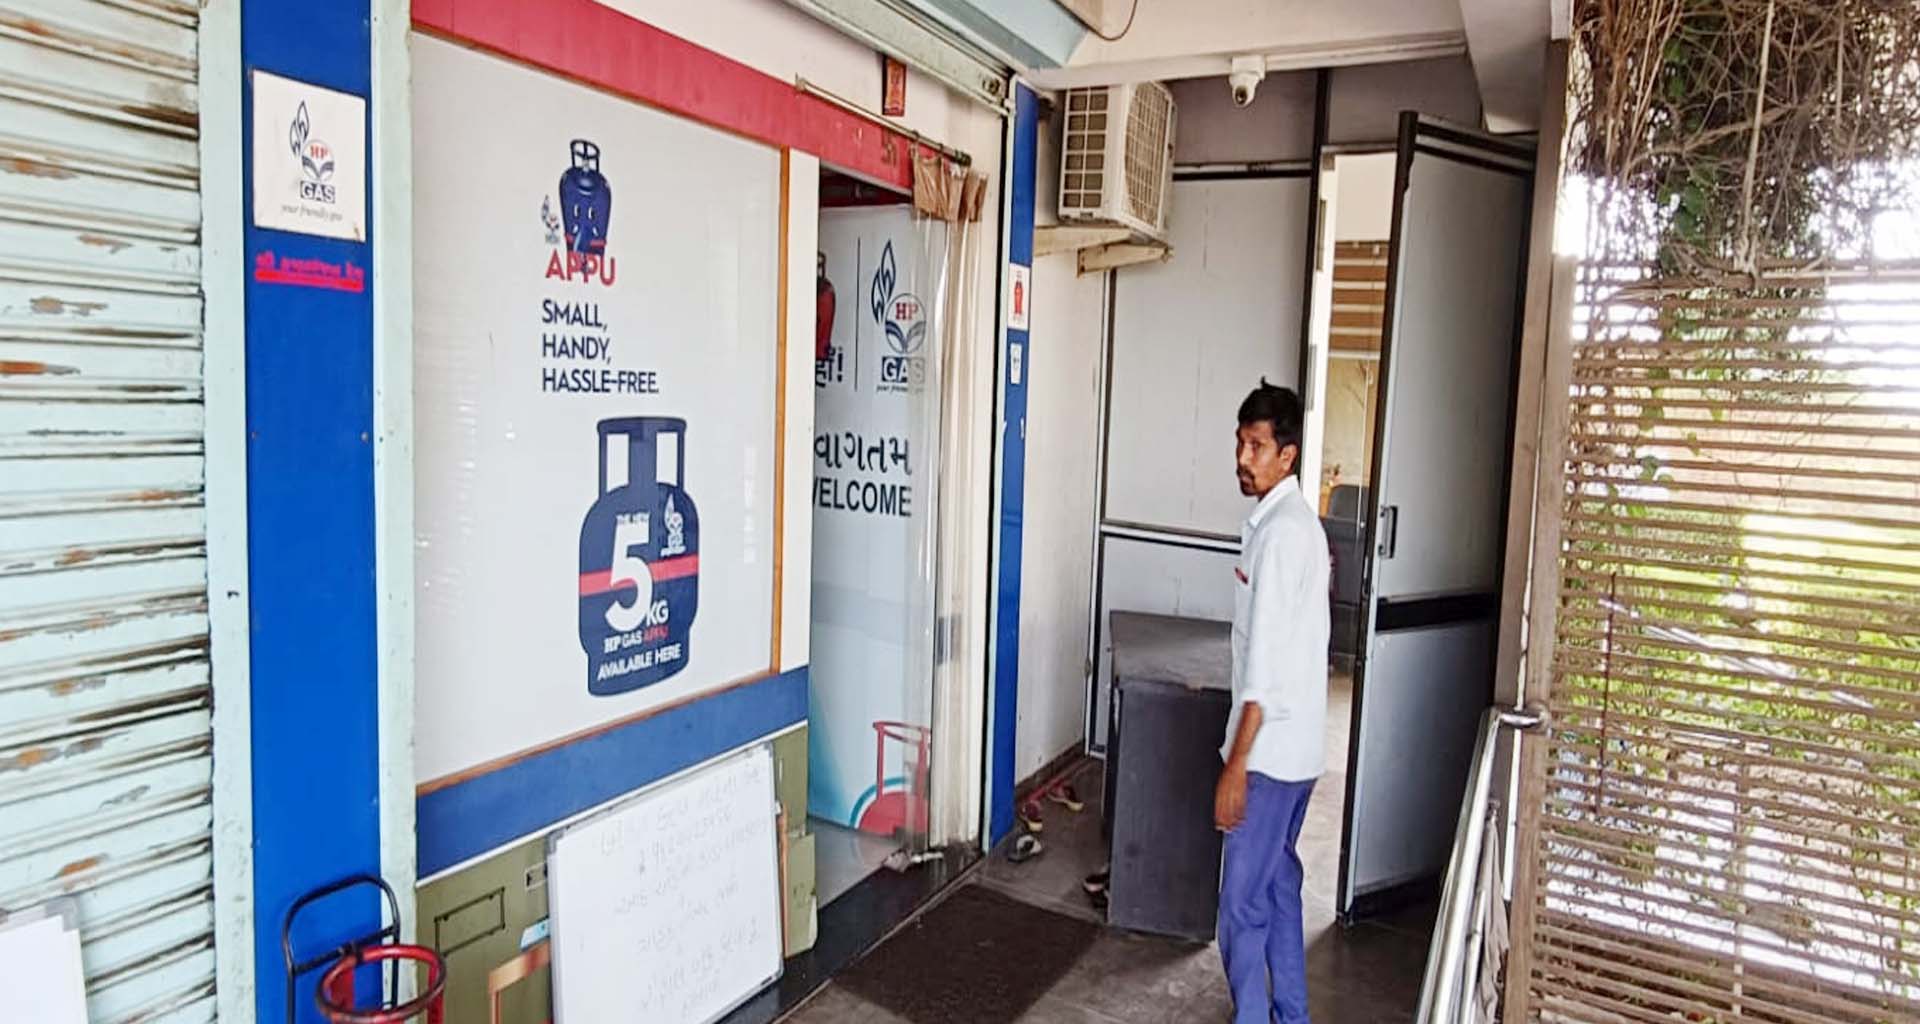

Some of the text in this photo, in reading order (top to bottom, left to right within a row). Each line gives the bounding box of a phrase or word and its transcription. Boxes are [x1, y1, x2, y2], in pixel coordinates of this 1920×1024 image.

[310, 145, 330, 161] HP
[302, 181, 335, 204] GAS
[545, 248, 616, 287] APPU
[542, 298, 608, 333] SMALL,
[895, 302, 919, 321] HP
[542, 333, 612, 365] HANDY,
[542, 367, 660, 393] HASSLE-FREE.
[882, 357, 924, 384] GAS
[605, 520, 653, 632] 5
[647, 599, 669, 627] KG
[604, 635, 621, 654] HP
[622, 629, 642, 649] GAS
[597, 643, 682, 681] AVAILABLE HERE
